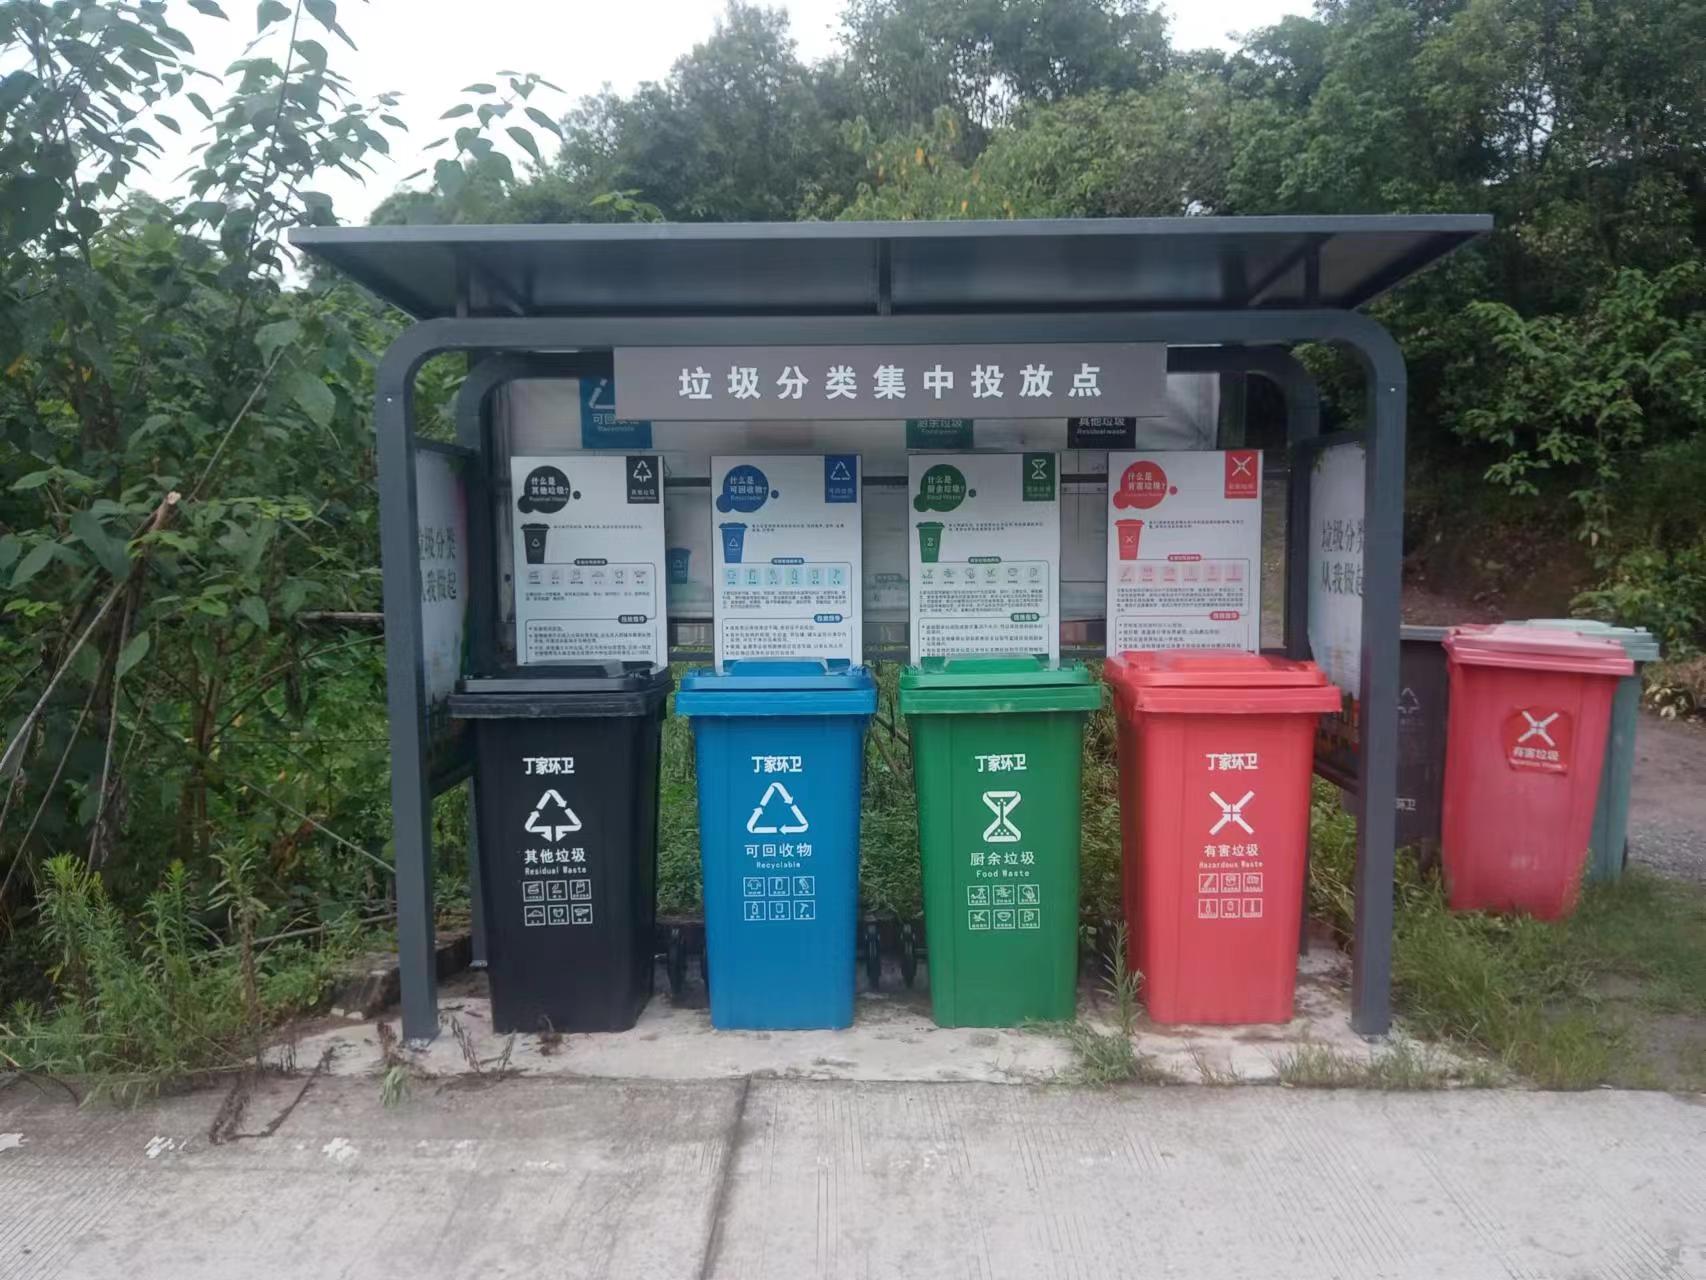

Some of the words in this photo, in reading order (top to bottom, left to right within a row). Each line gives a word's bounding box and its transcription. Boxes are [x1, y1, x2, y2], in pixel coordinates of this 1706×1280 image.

[678, 363, 1102, 400] 垃圾分类集中投放点
[730, 475, 755, 485] 什么是
[928, 475, 952, 484] 什么是
[1128, 472, 1153, 481] 什么是
[522, 756, 575, 775] 丁家环卫
[751, 755, 802, 774] 丁家环卫
[974, 753, 1027, 773] 丁家环卫
[1205, 752, 1258, 771] 丁家环卫
[524, 848, 586, 864] 其他垃圾
[744, 843, 812, 858] 可回收物
[1204, 844, 1259, 857] 有害垃圾
[756, 861, 801, 869] Recyclable
[970, 851, 1035, 866] 厨余垃圾
[524, 866, 560, 876] Residual
[563, 865, 587, 874] Waste
[976, 870, 999, 878] Food
[1002, 869, 1030, 878] Waste
